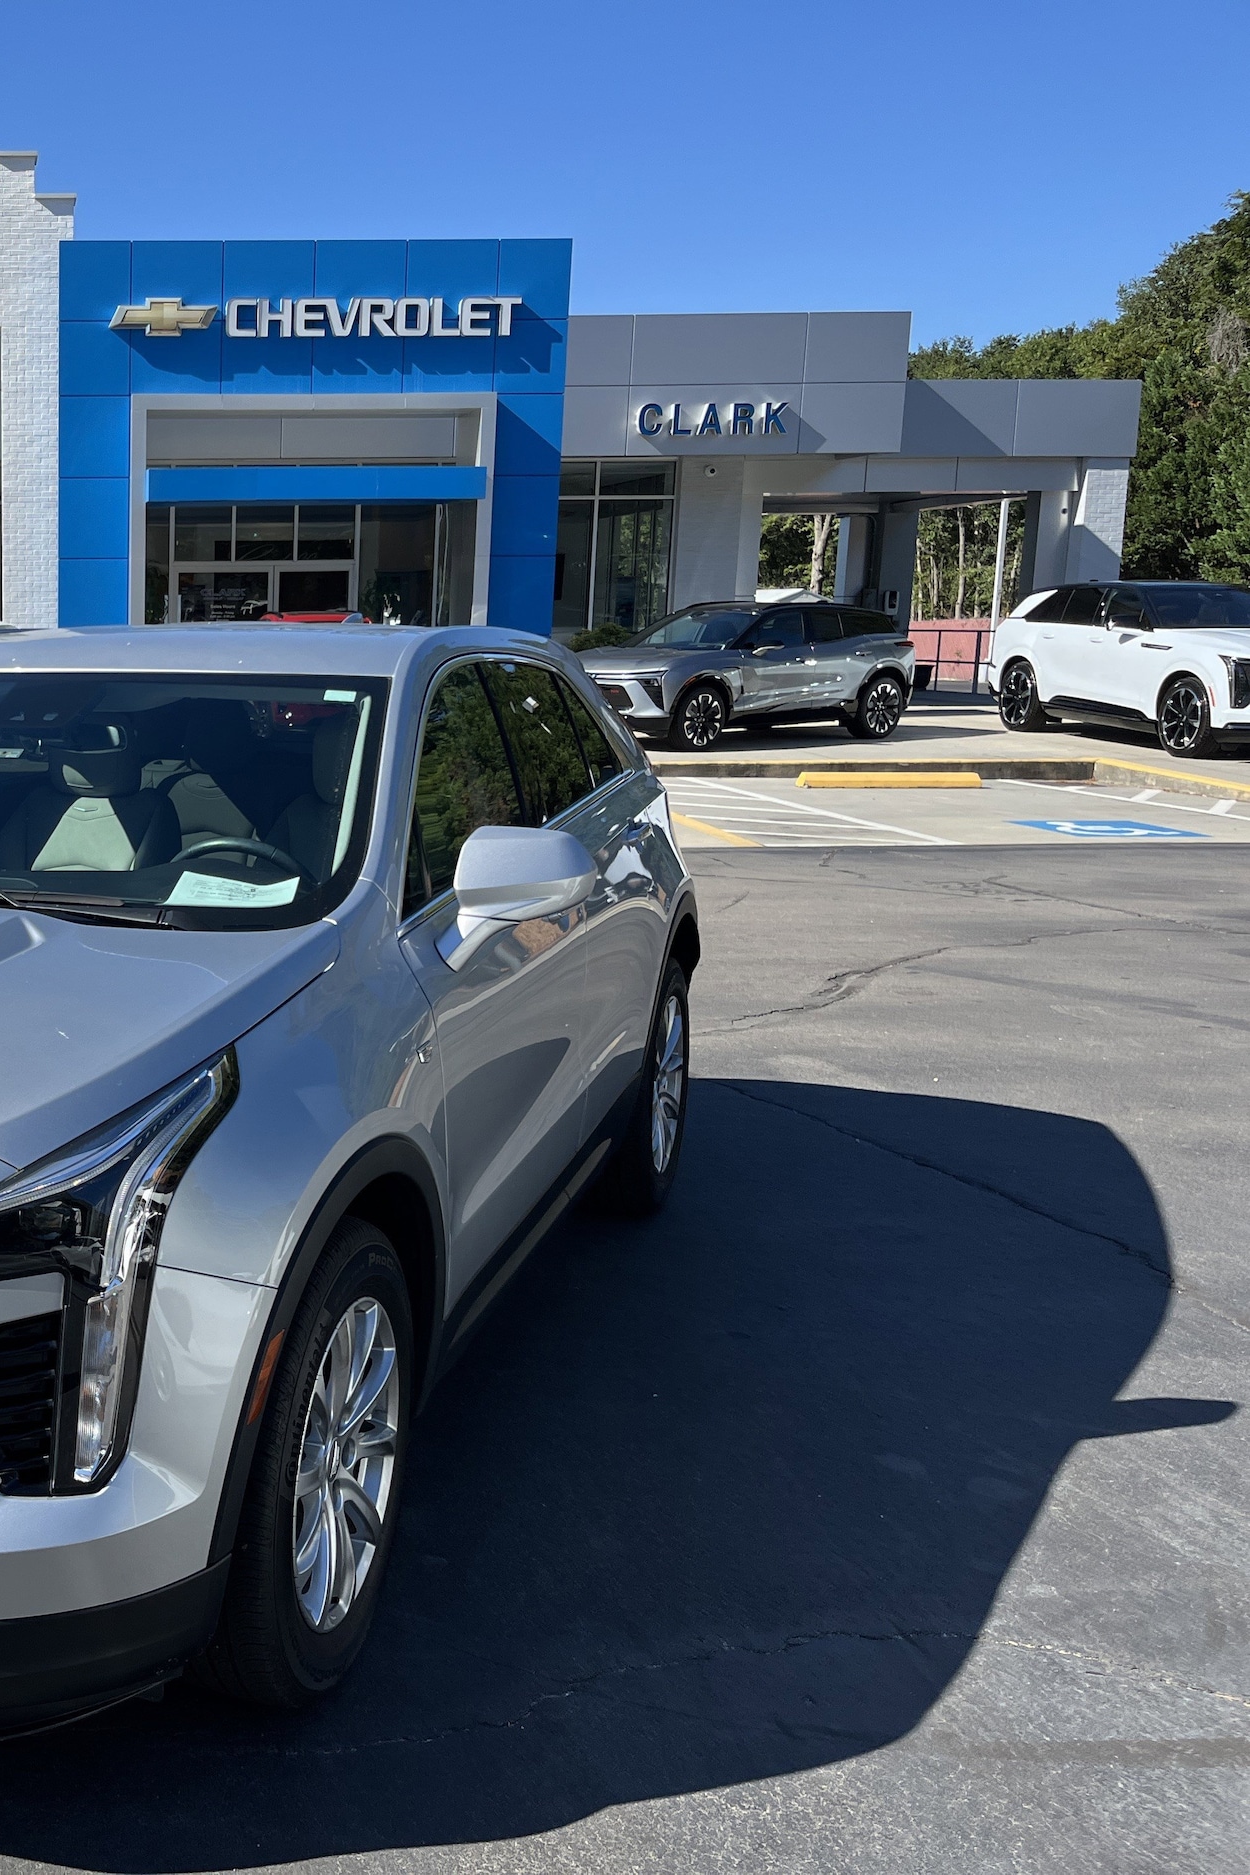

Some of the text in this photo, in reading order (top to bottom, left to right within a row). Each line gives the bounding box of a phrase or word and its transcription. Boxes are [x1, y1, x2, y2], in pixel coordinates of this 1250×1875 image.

[225, 296, 522, 338] CHEVROLET
[636, 402, 789, 436] CLARK
[199, 588, 247, 597] CLARK
